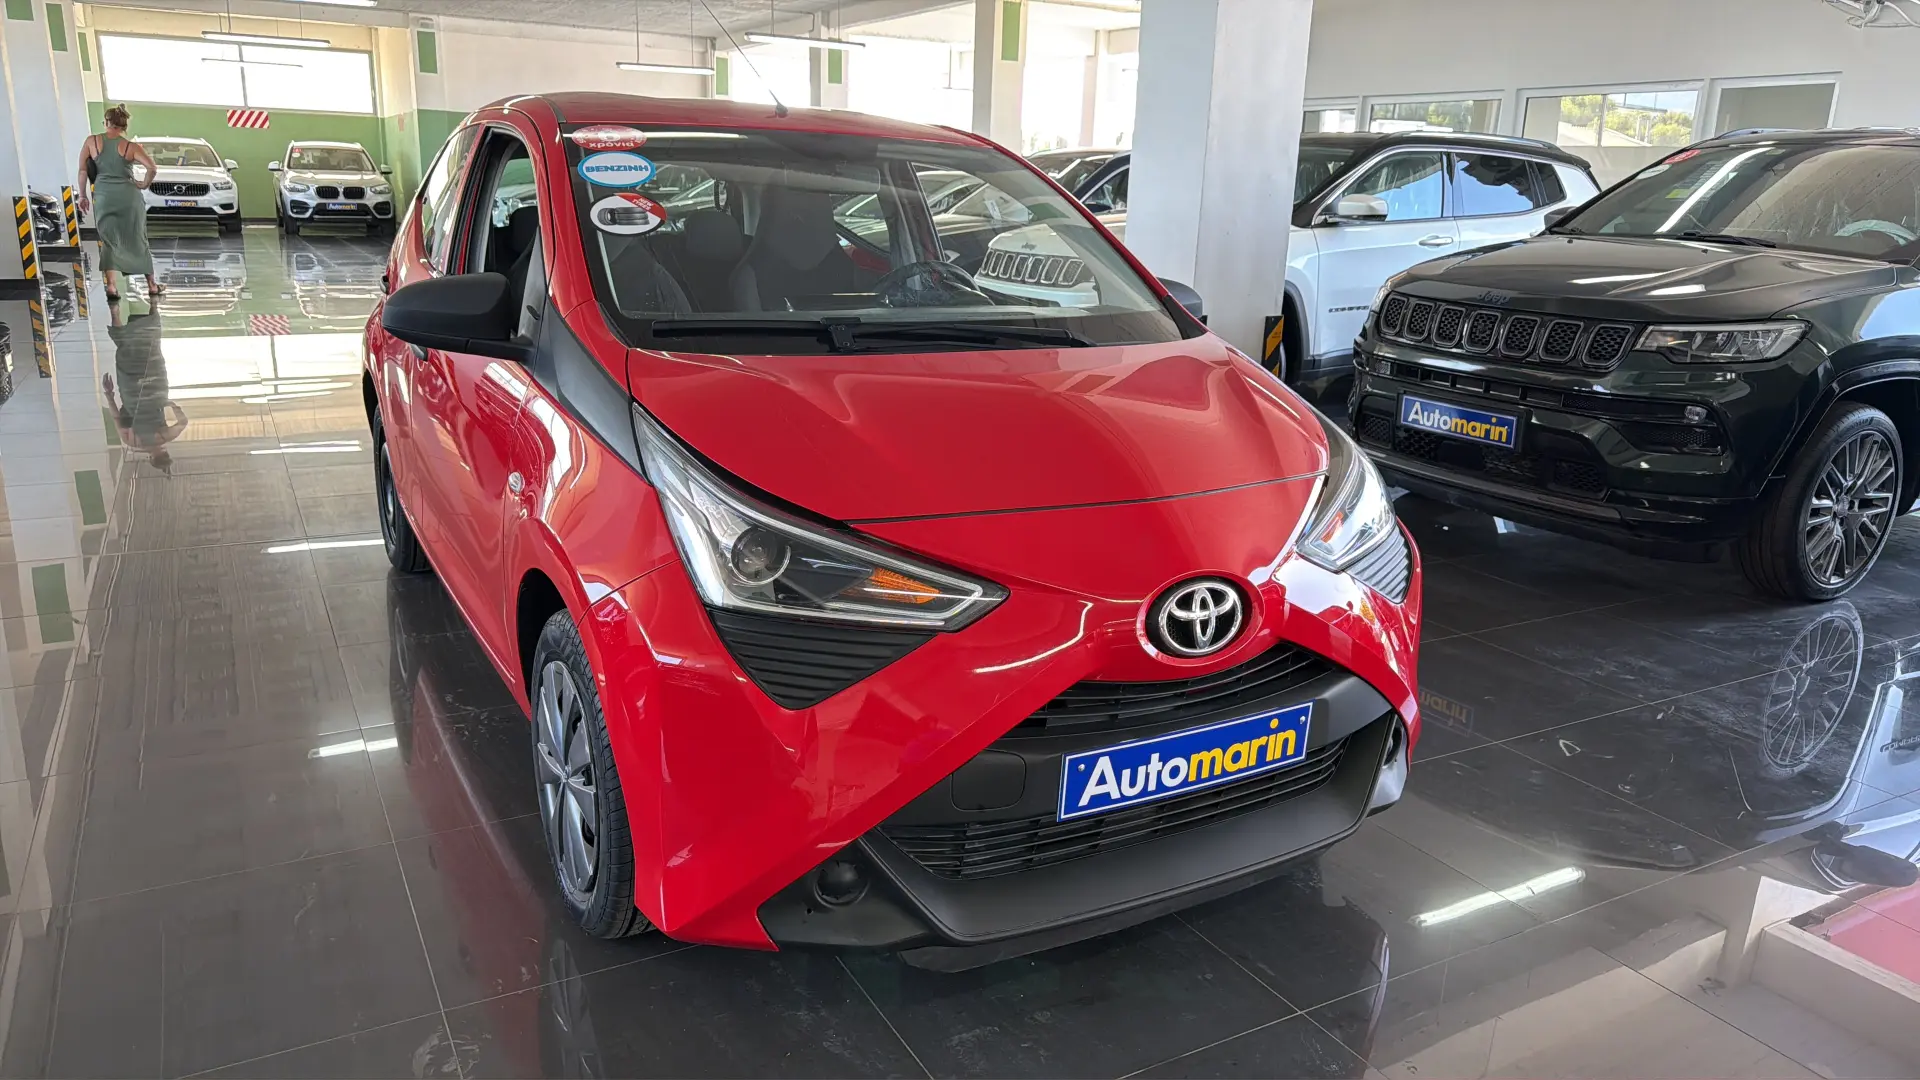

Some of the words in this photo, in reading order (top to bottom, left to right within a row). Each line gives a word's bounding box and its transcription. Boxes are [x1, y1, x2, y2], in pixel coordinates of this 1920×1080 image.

[167, 199, 197, 207] Automarin
[1477, 291, 1511, 305] Jeep
[1407, 401, 1508, 442] Automarin
[1078, 718, 1297, 807] Automarin
